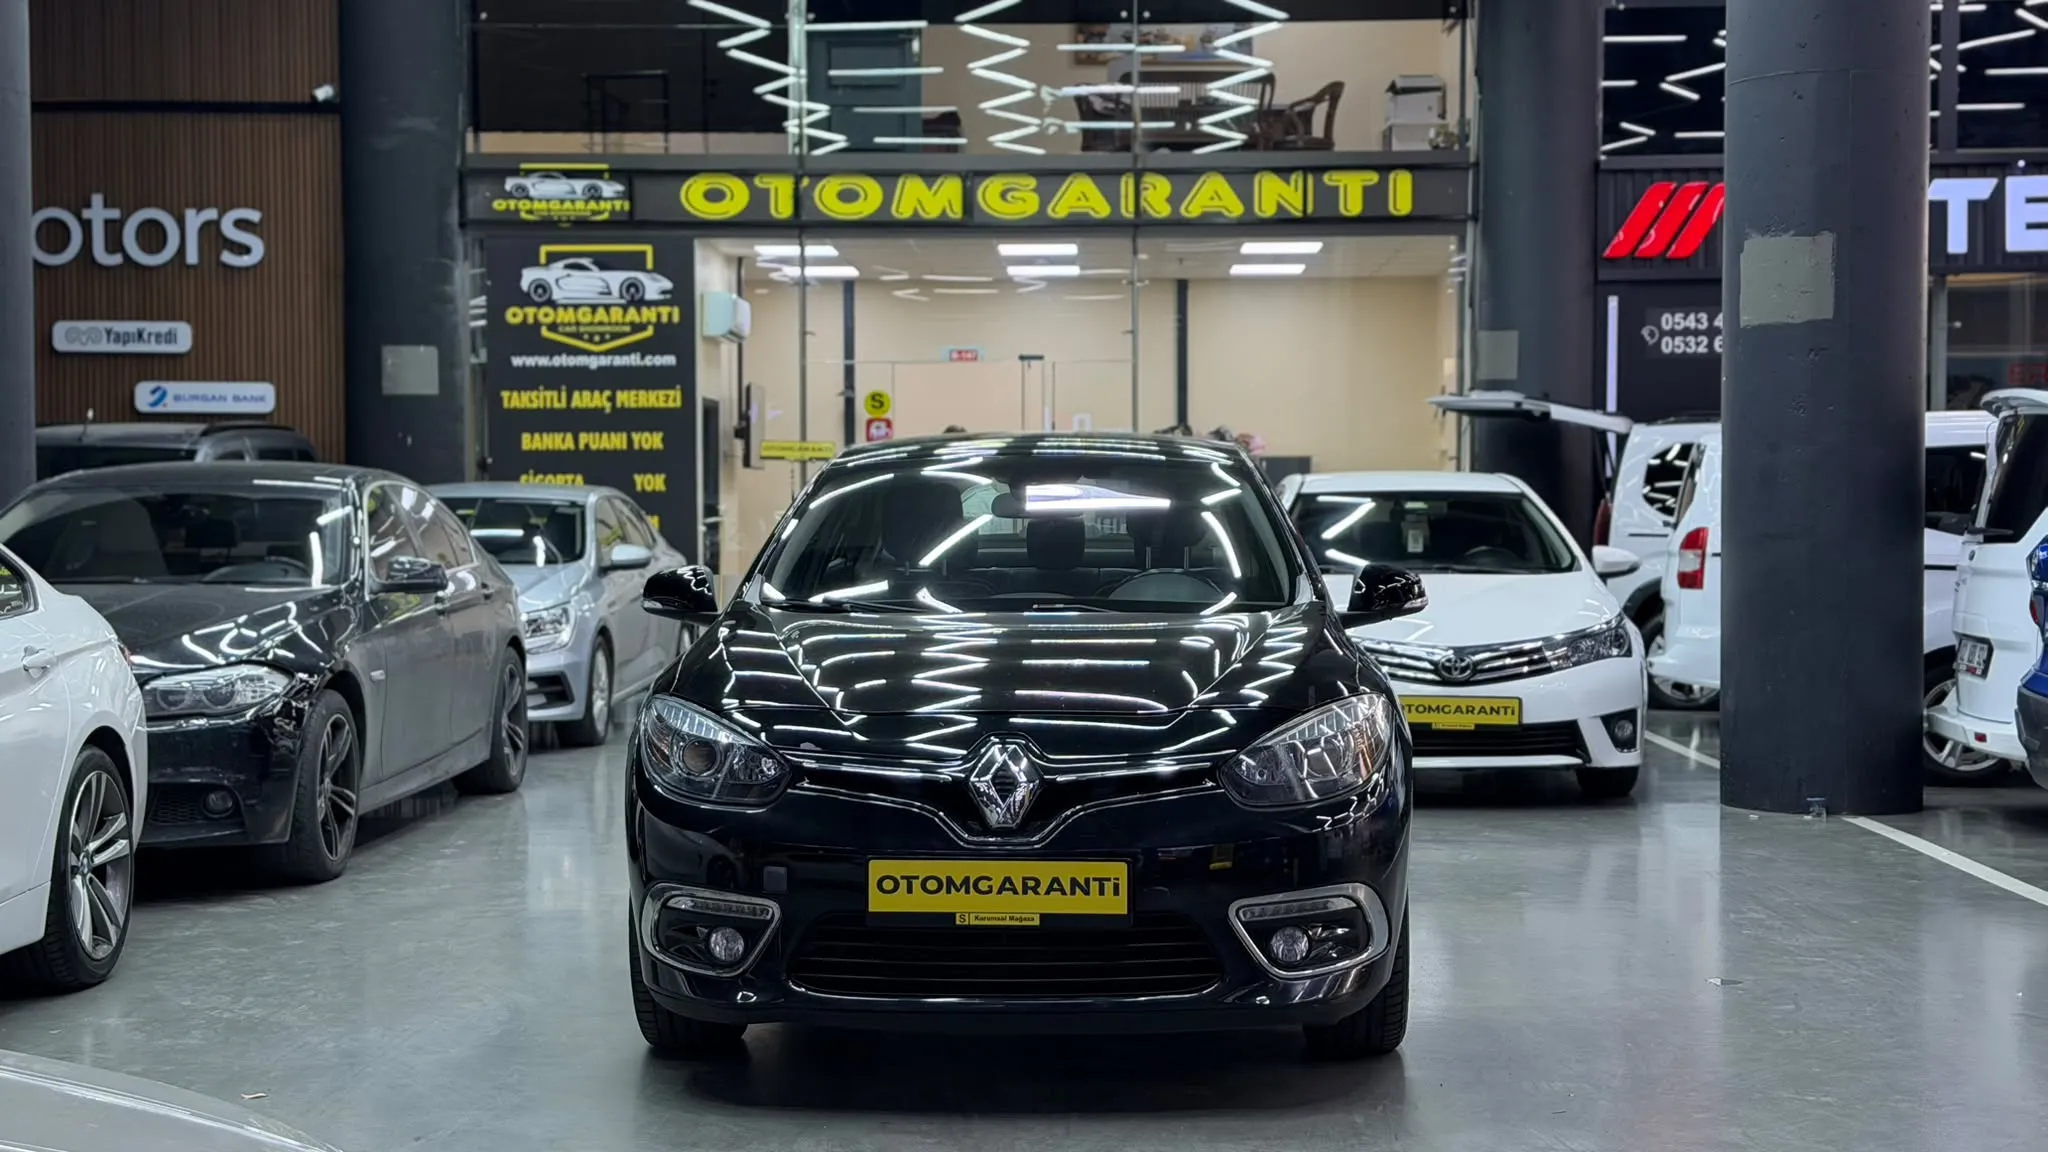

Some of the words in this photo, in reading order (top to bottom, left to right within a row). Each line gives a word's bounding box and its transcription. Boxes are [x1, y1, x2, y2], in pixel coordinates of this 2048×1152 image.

[680, 170, 1413, 220] OTOMGARANTI
[492, 199, 630, 212] OTOMGARANTI
[1928, 175, 2048, 254] TE
[32, 193, 265, 268] otors
[505, 305, 680, 325] OTOMGARANTI
[1661, 312, 1709, 331] 0543
[104, 327, 178, 346] YapıKredi
[1661, 335, 1709, 354] 0532
[511, 352, 677, 370] www.otomgaranti.com
[233, 394, 266, 403] BANK
[501, 385, 567, 409] TAKSİTLİ
[571, 389, 612, 414] ARAÇ
[616, 385, 682, 409] MERKEZİ
[521, 432, 575, 451] BANKA
[578, 432, 628, 451] PUANI
[632, 431, 664, 451] YOK
[633, 473, 667, 492] YOK
